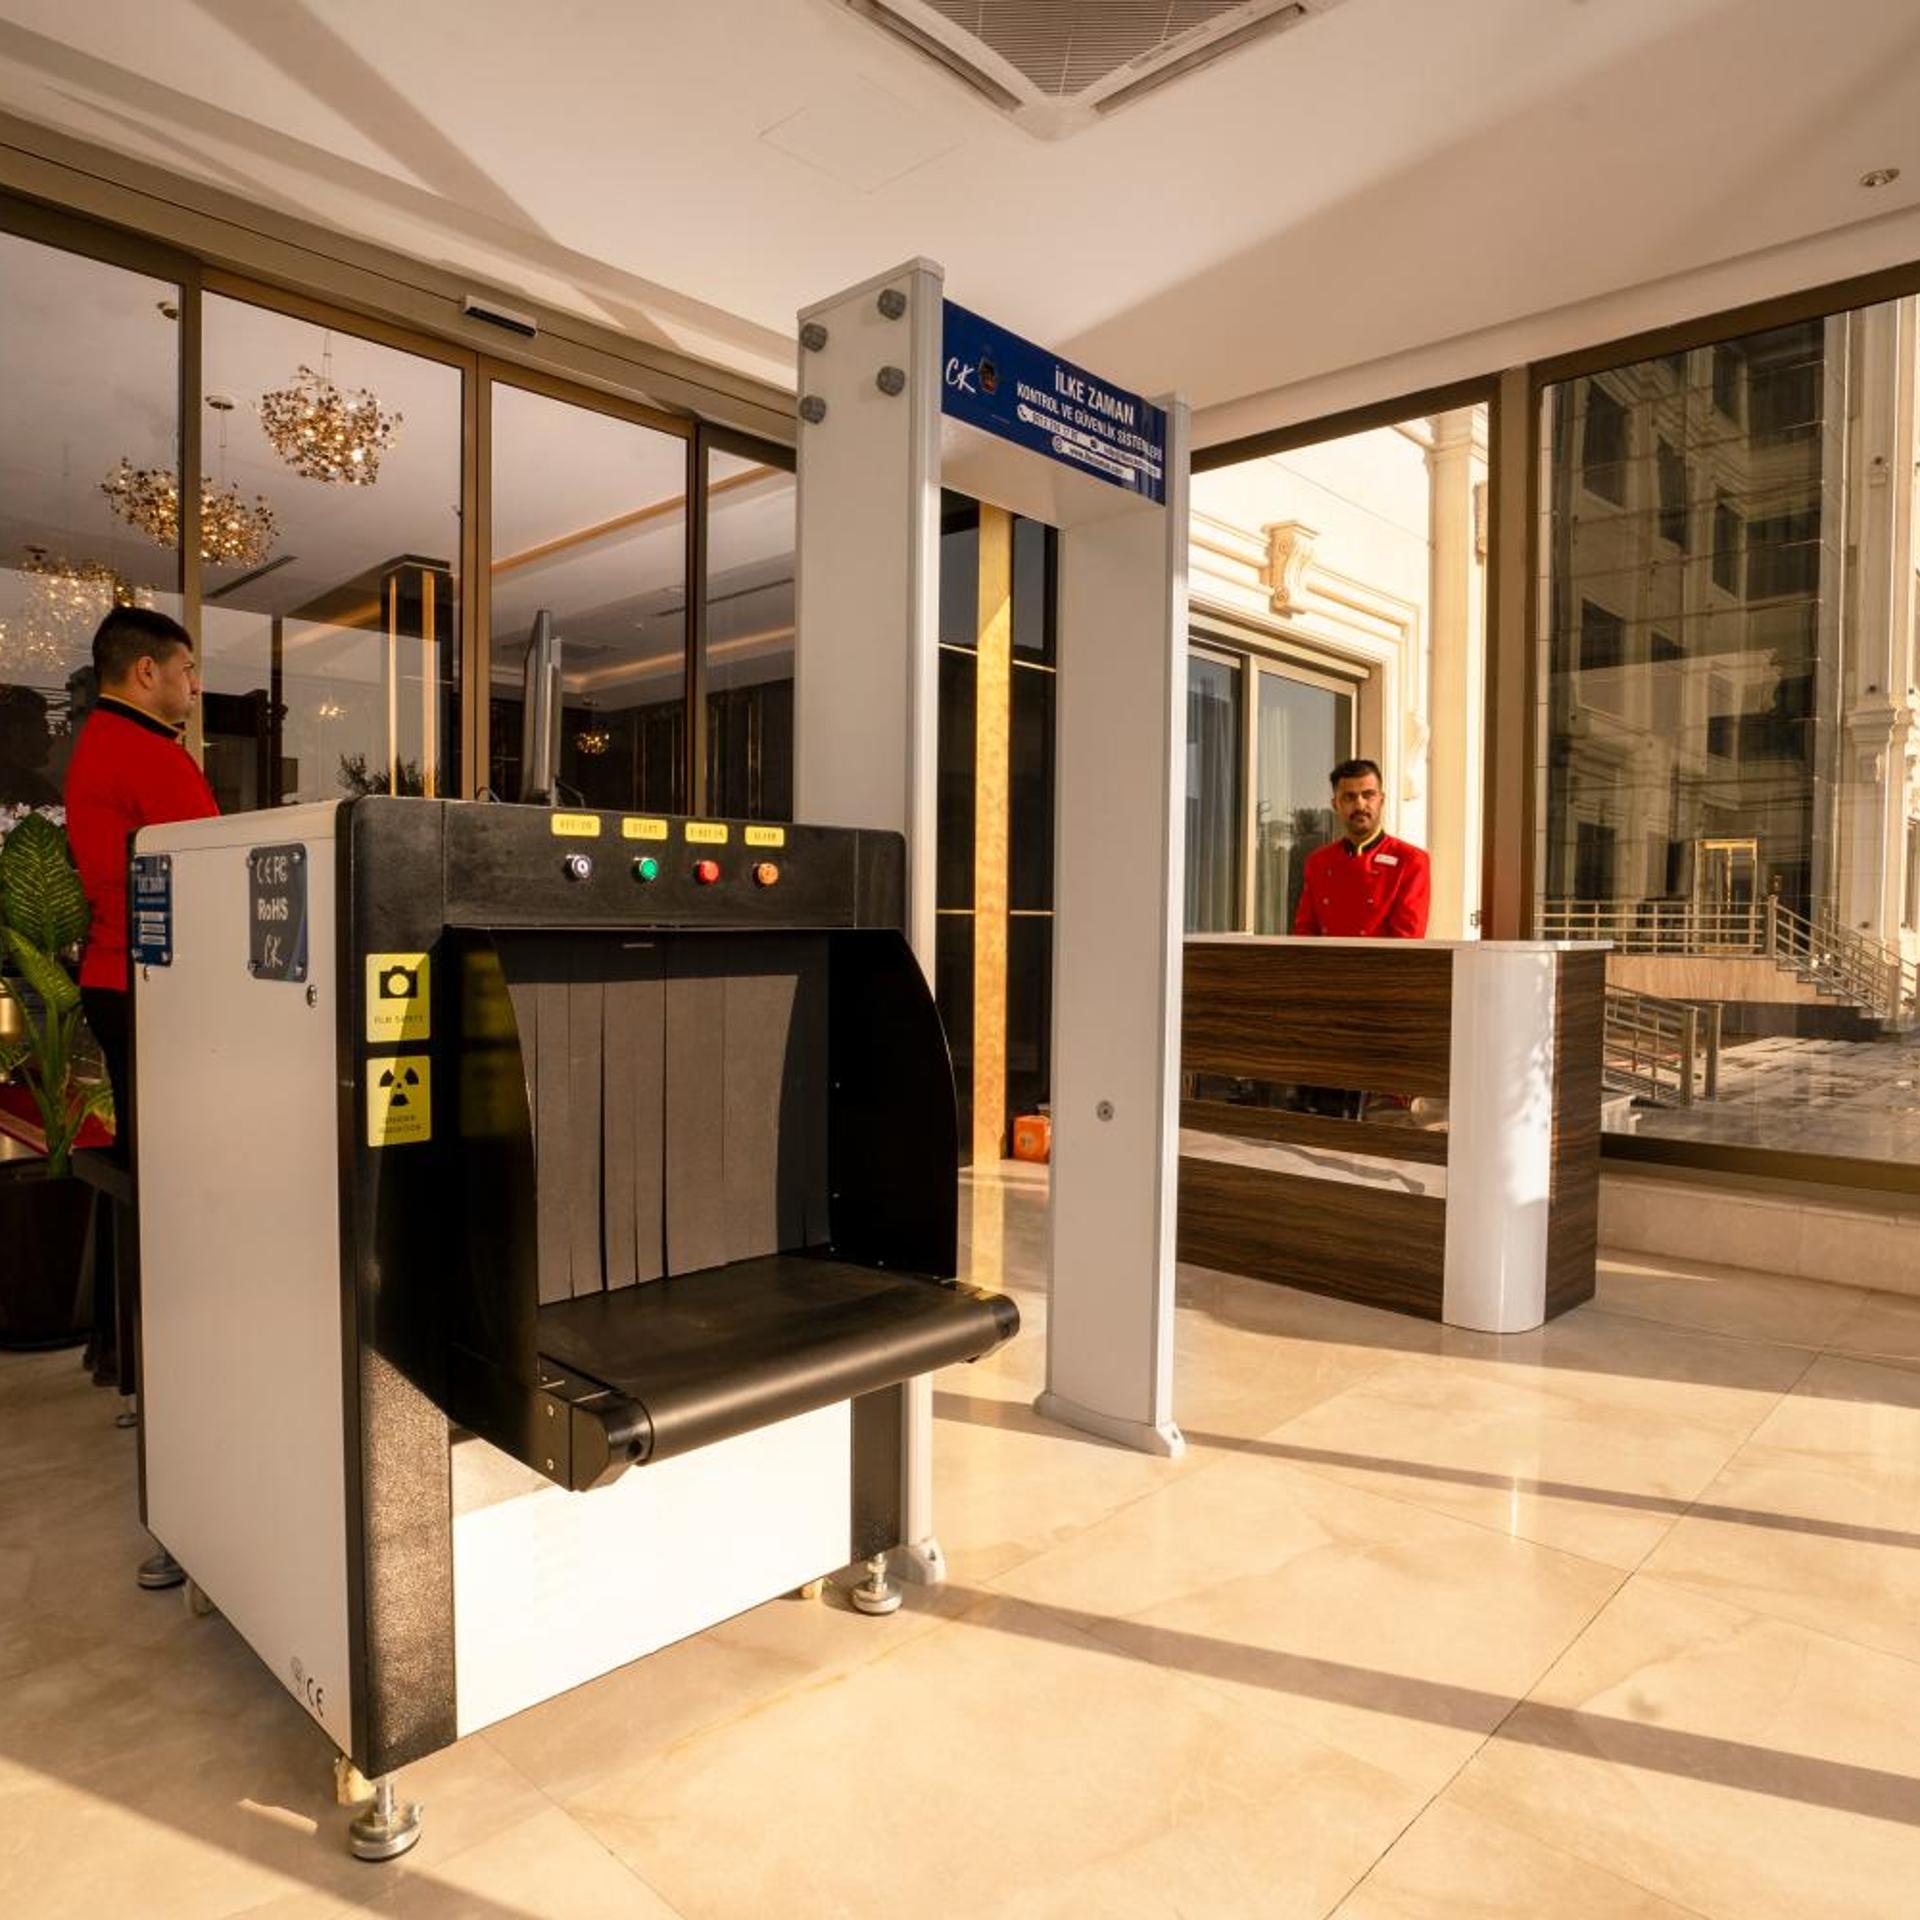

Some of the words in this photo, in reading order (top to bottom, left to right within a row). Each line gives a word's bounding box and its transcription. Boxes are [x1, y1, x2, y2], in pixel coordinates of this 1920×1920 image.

[946, 357, 976, 393] CK
[1056, 364, 1085, 403] İLKE
[1088, 386, 1134, 427] ZAMAN
[1017, 380, 1059, 415] KONTROL
[1062, 402, 1073, 421] VE
[257, 897, 289, 921] RoHS
[306, 1677, 324, 1718] CE
